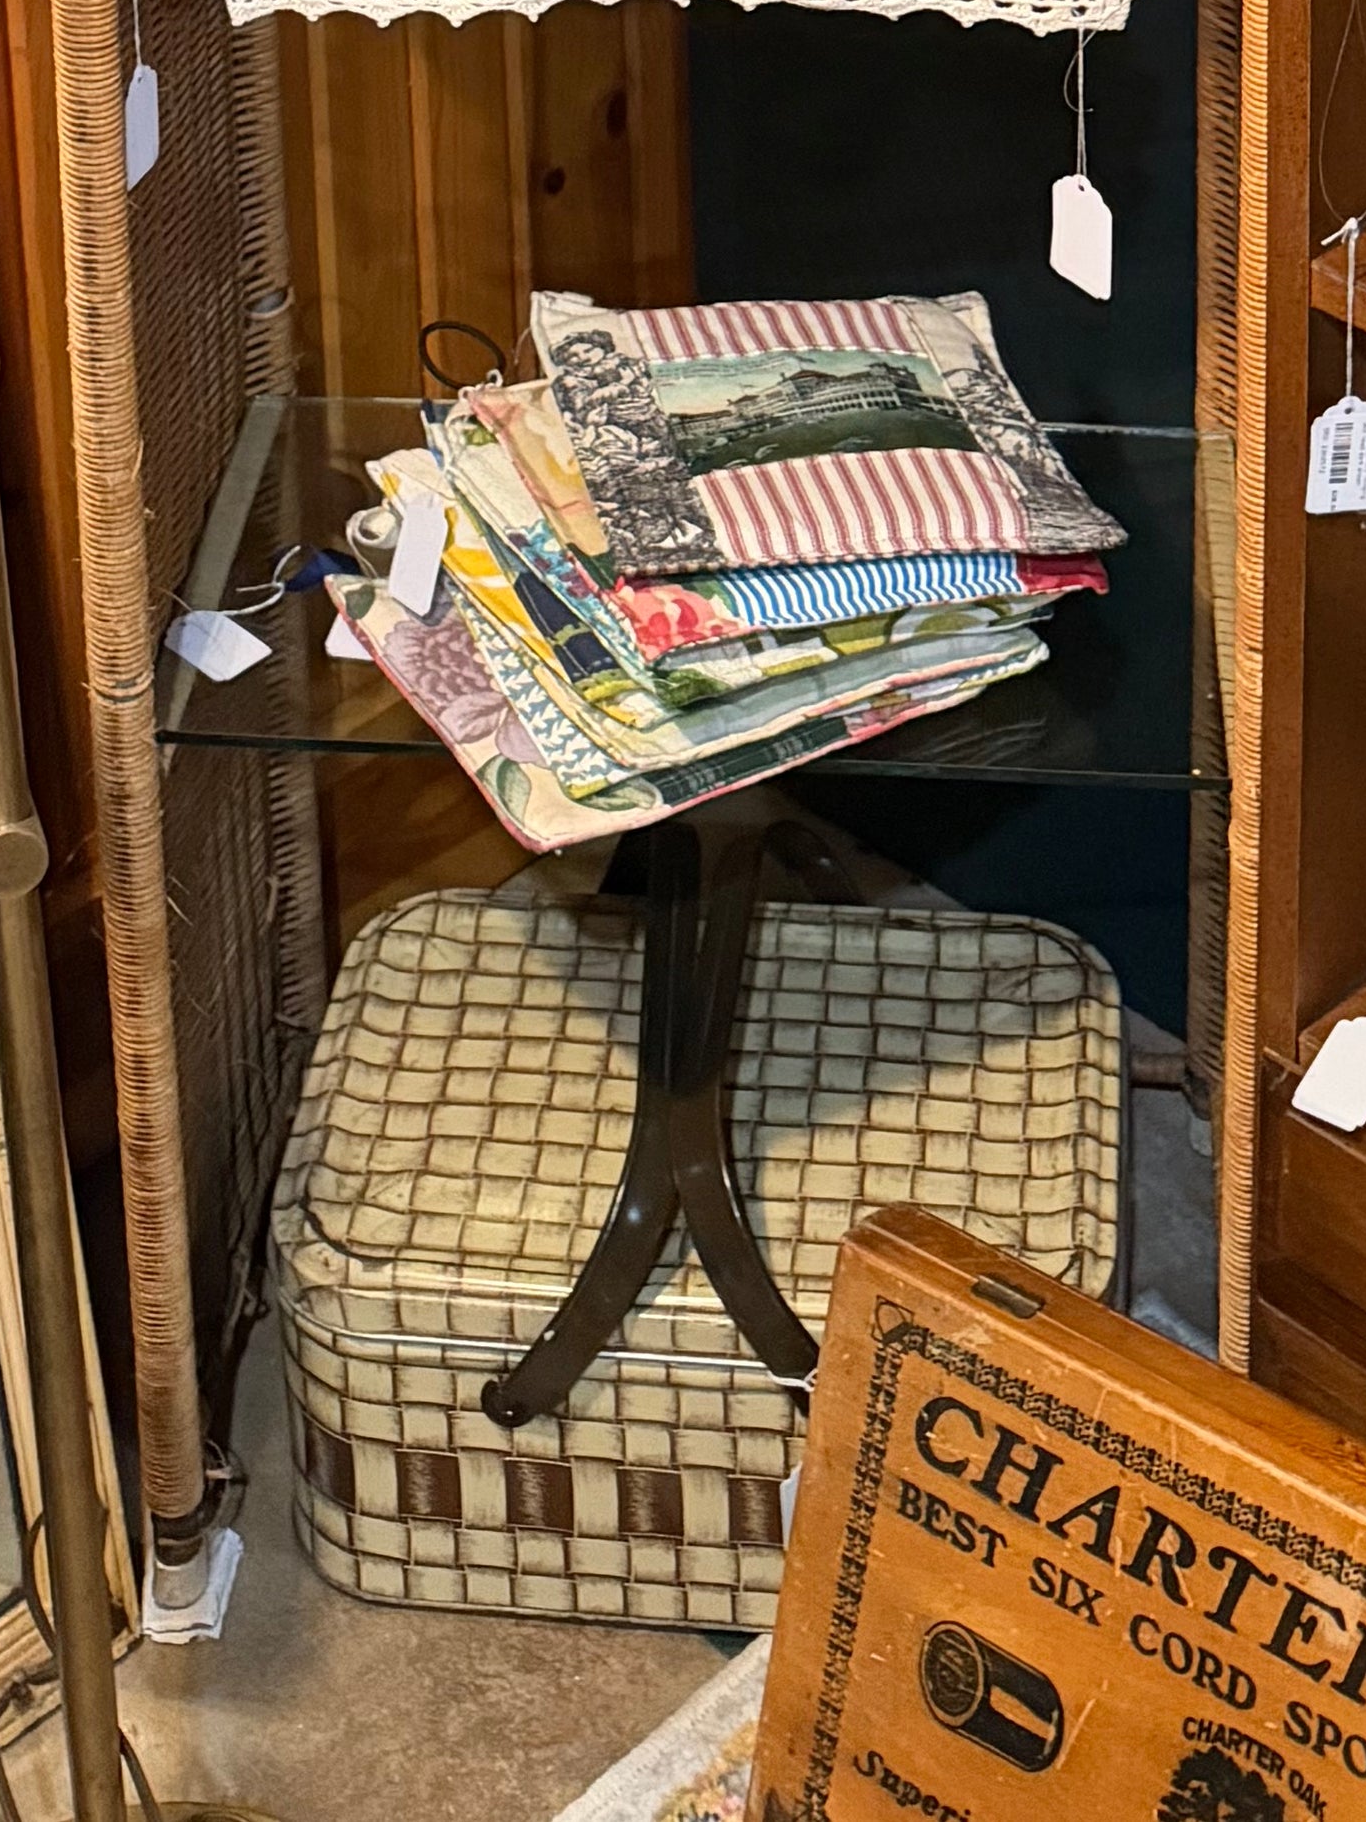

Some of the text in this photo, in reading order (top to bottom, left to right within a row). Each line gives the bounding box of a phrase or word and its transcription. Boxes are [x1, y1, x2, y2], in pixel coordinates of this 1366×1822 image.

[896, 1477, 1007, 1568] BEST
[1029, 1557, 1105, 1627] SIX
[1129, 1614, 1258, 1711] CORD
[1182, 1716, 1328, 1822] CHARTER OAK
